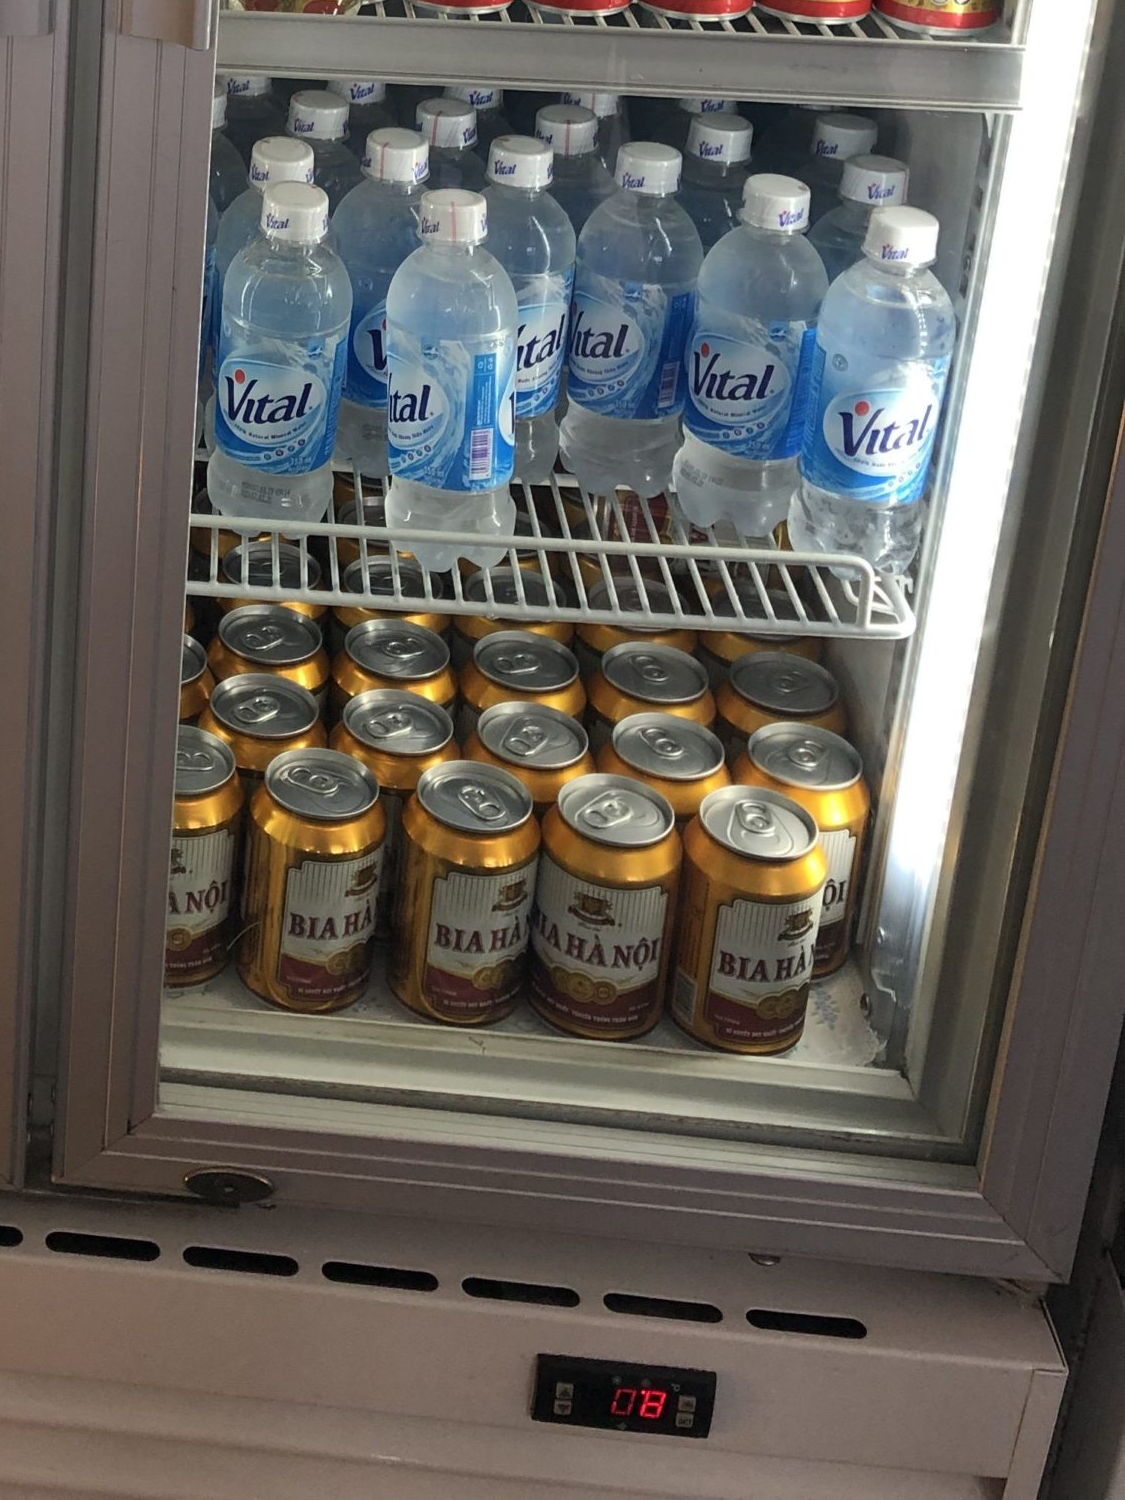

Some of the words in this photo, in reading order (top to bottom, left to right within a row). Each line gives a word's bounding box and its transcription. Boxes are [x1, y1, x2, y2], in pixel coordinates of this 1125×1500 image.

[227, 78, 250, 95] Vital
[350, 83, 375, 100] Vital
[469, 90, 493, 106] Vital
[294, 118, 315, 133] Vital
[699, 141, 723, 157] Vital
[251, 164, 270, 181] Vital
[494, 160, 517, 175] Vital
[622, 172, 645, 188] Vital
[868, 183, 895, 200] Vital
[266, 213, 290, 229] Vital
[421, 218, 441, 235] Vital
[778, 209, 804, 227] Vital
[881, 244, 909, 260] Vital
[693, 342, 774, 401] Vital
[225, 369, 313, 425] Vital
[837, 400, 933, 457] Vital
[185, 879, 228, 914] NỘI
[823, 879, 848, 912] ỘI
[288, 911, 338, 941] BIA
[342, 899, 372, 937] HÀ
[434, 923, 485, 954] BIA
[566, 931, 608, 968] HÀ
[612, 935, 661, 972] NỘI
[718, 950, 770, 983] BIA
